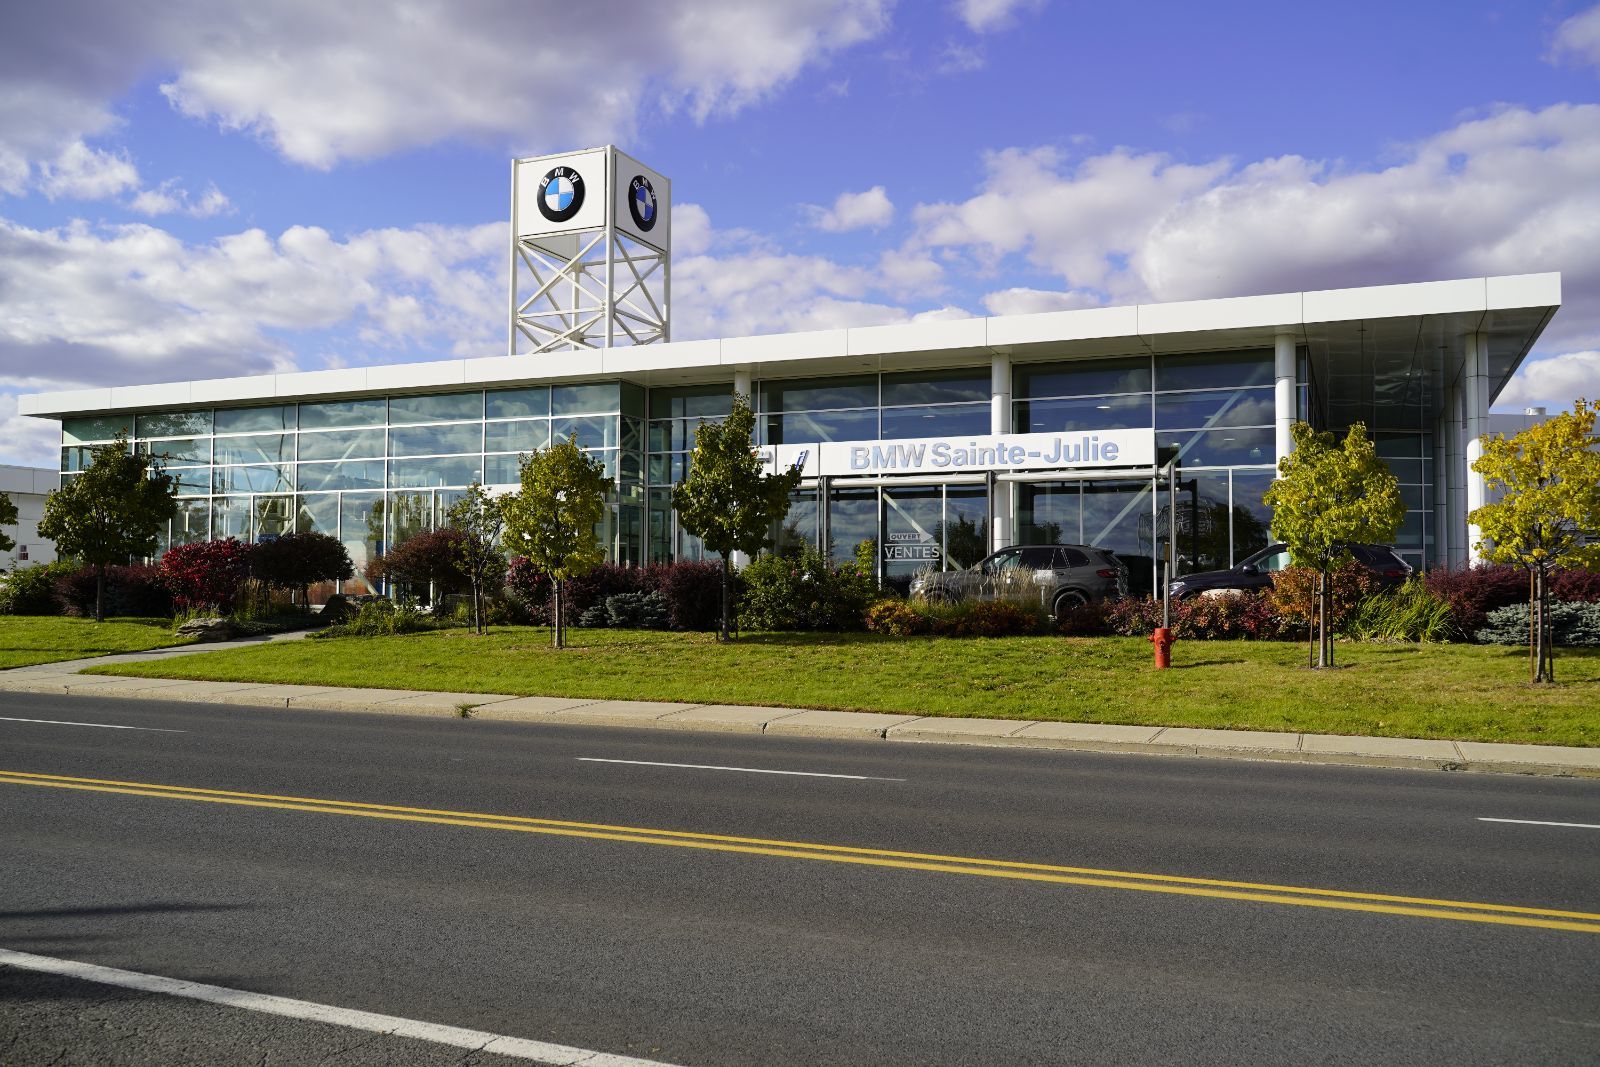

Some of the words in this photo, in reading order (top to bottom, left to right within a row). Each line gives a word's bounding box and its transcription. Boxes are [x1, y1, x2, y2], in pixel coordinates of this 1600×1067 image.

[540, 167, 580, 188] BMW
[850, 443, 926, 470] BMW
[931, 436, 1119, 467] Sainte-Julie
[884, 546, 940, 558] VENTES
